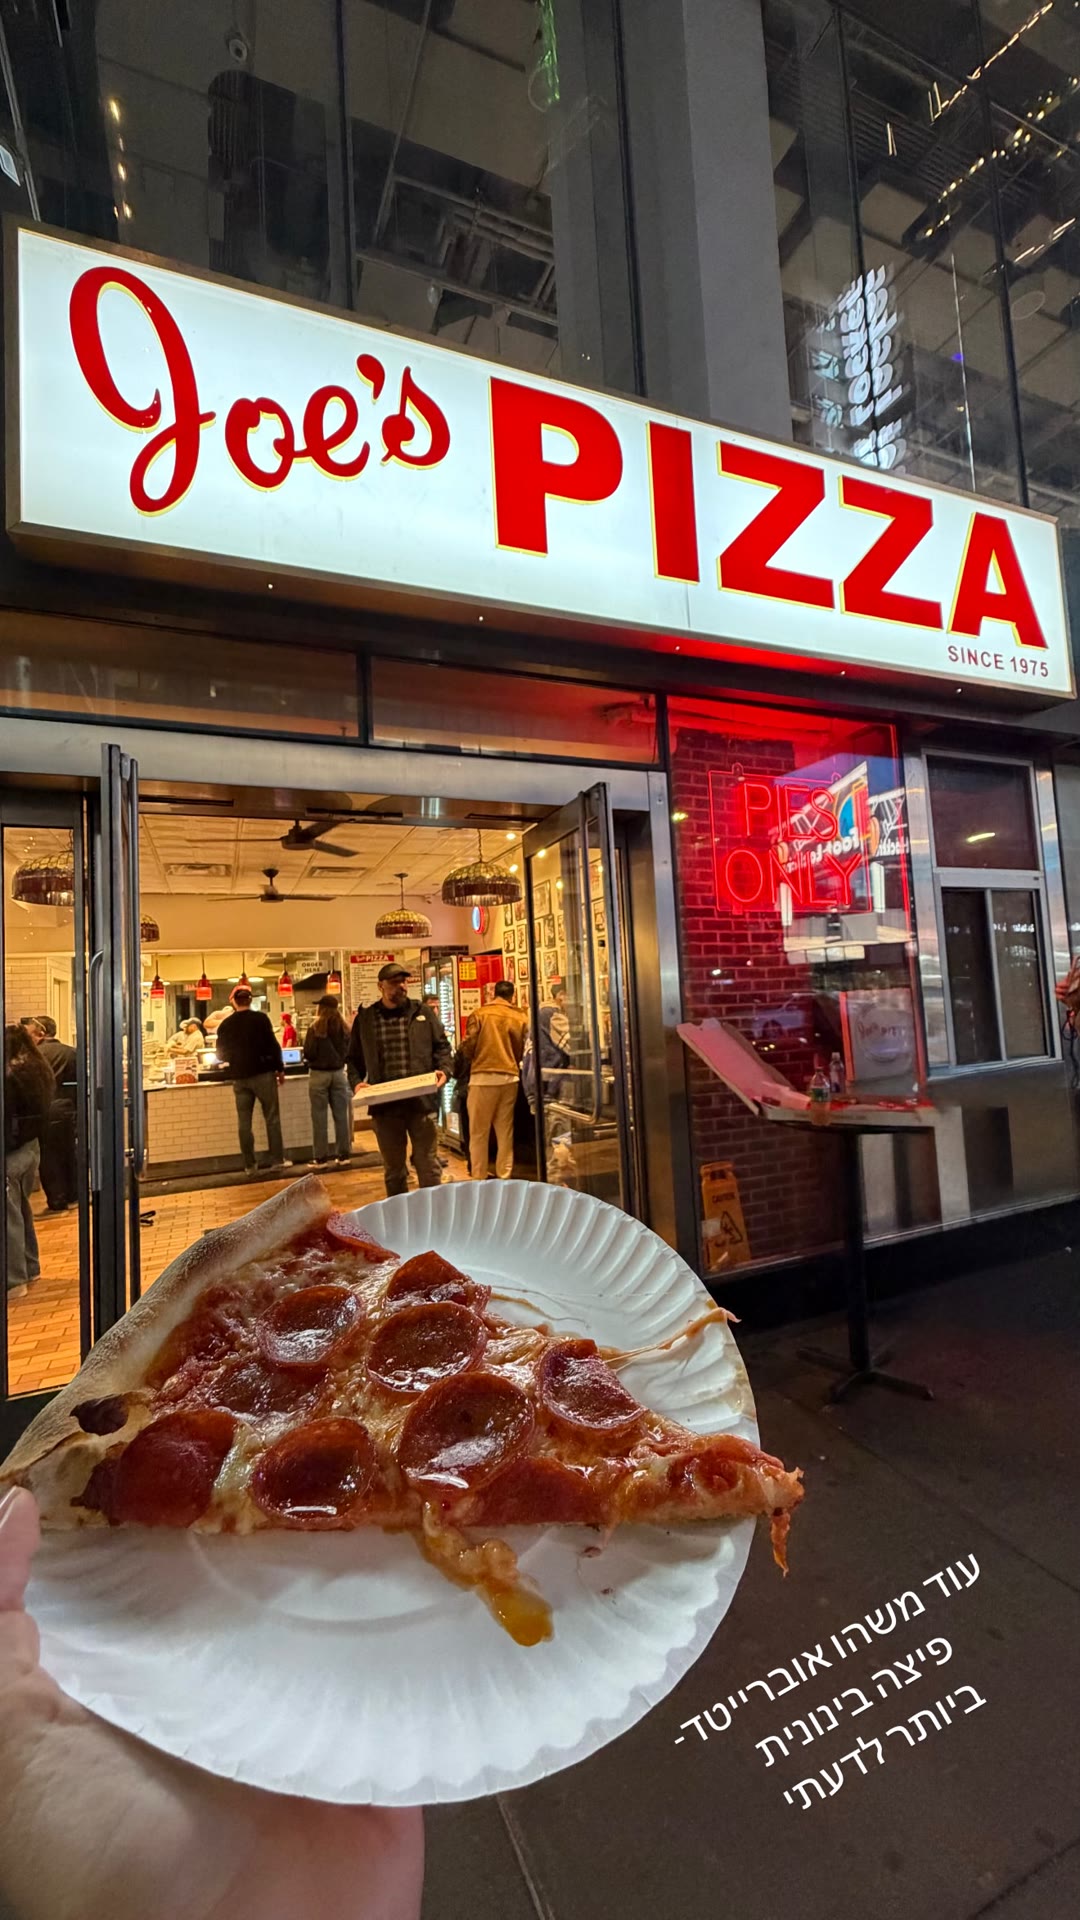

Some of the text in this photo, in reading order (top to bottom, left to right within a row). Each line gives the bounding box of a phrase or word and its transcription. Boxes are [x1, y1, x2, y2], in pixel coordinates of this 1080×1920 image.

[69, 266, 1047, 652] Joe's PIZZA
[947, 645, 1049, 677] SINCE 1975
[743, 782, 838, 841] PIES
[724, 847, 862, 906] ONLY
[366, 954, 389, 962] PIZZA
